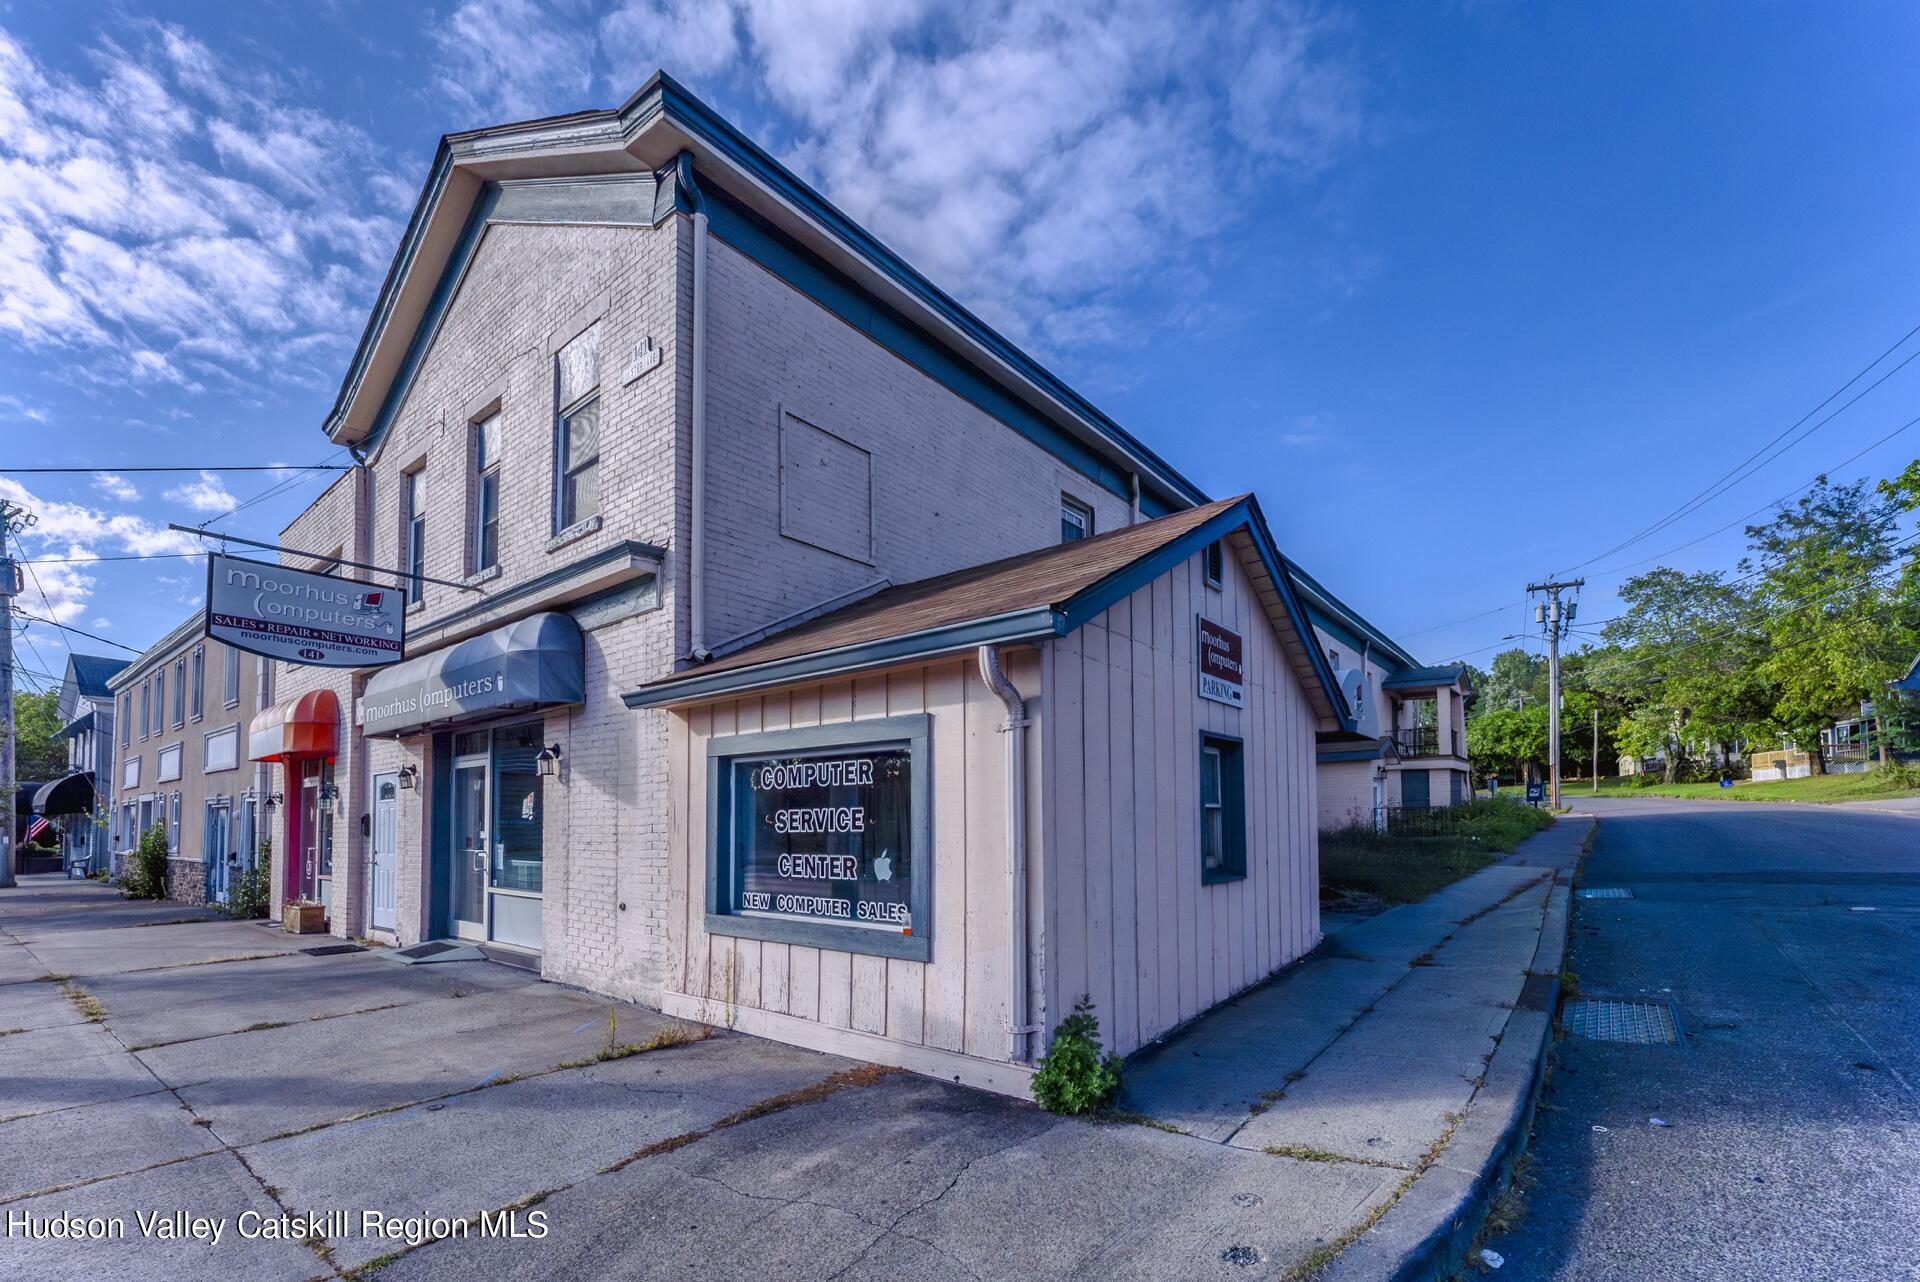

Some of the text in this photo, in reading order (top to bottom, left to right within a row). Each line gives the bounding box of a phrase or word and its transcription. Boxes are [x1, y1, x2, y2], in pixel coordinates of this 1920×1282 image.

[227, 568, 349, 606] moorhus
[214, 614, 399, 650] SALES REPAIR NETWORKING
[240, 631, 378, 657] moorhuscomputers.com
[1202, 630, 1229, 652] moorhus
[303, 649, 321, 660] 141
[1203, 677, 1232, 700] PARKING
[366, 697, 417, 723] moorhus
[761, 759, 873, 790] COMPUTER
[775, 807, 864, 833] SERVICE
[778, 853, 857, 880] CENTER
[743, 892, 908, 922] NEW COMPUTER SALES
